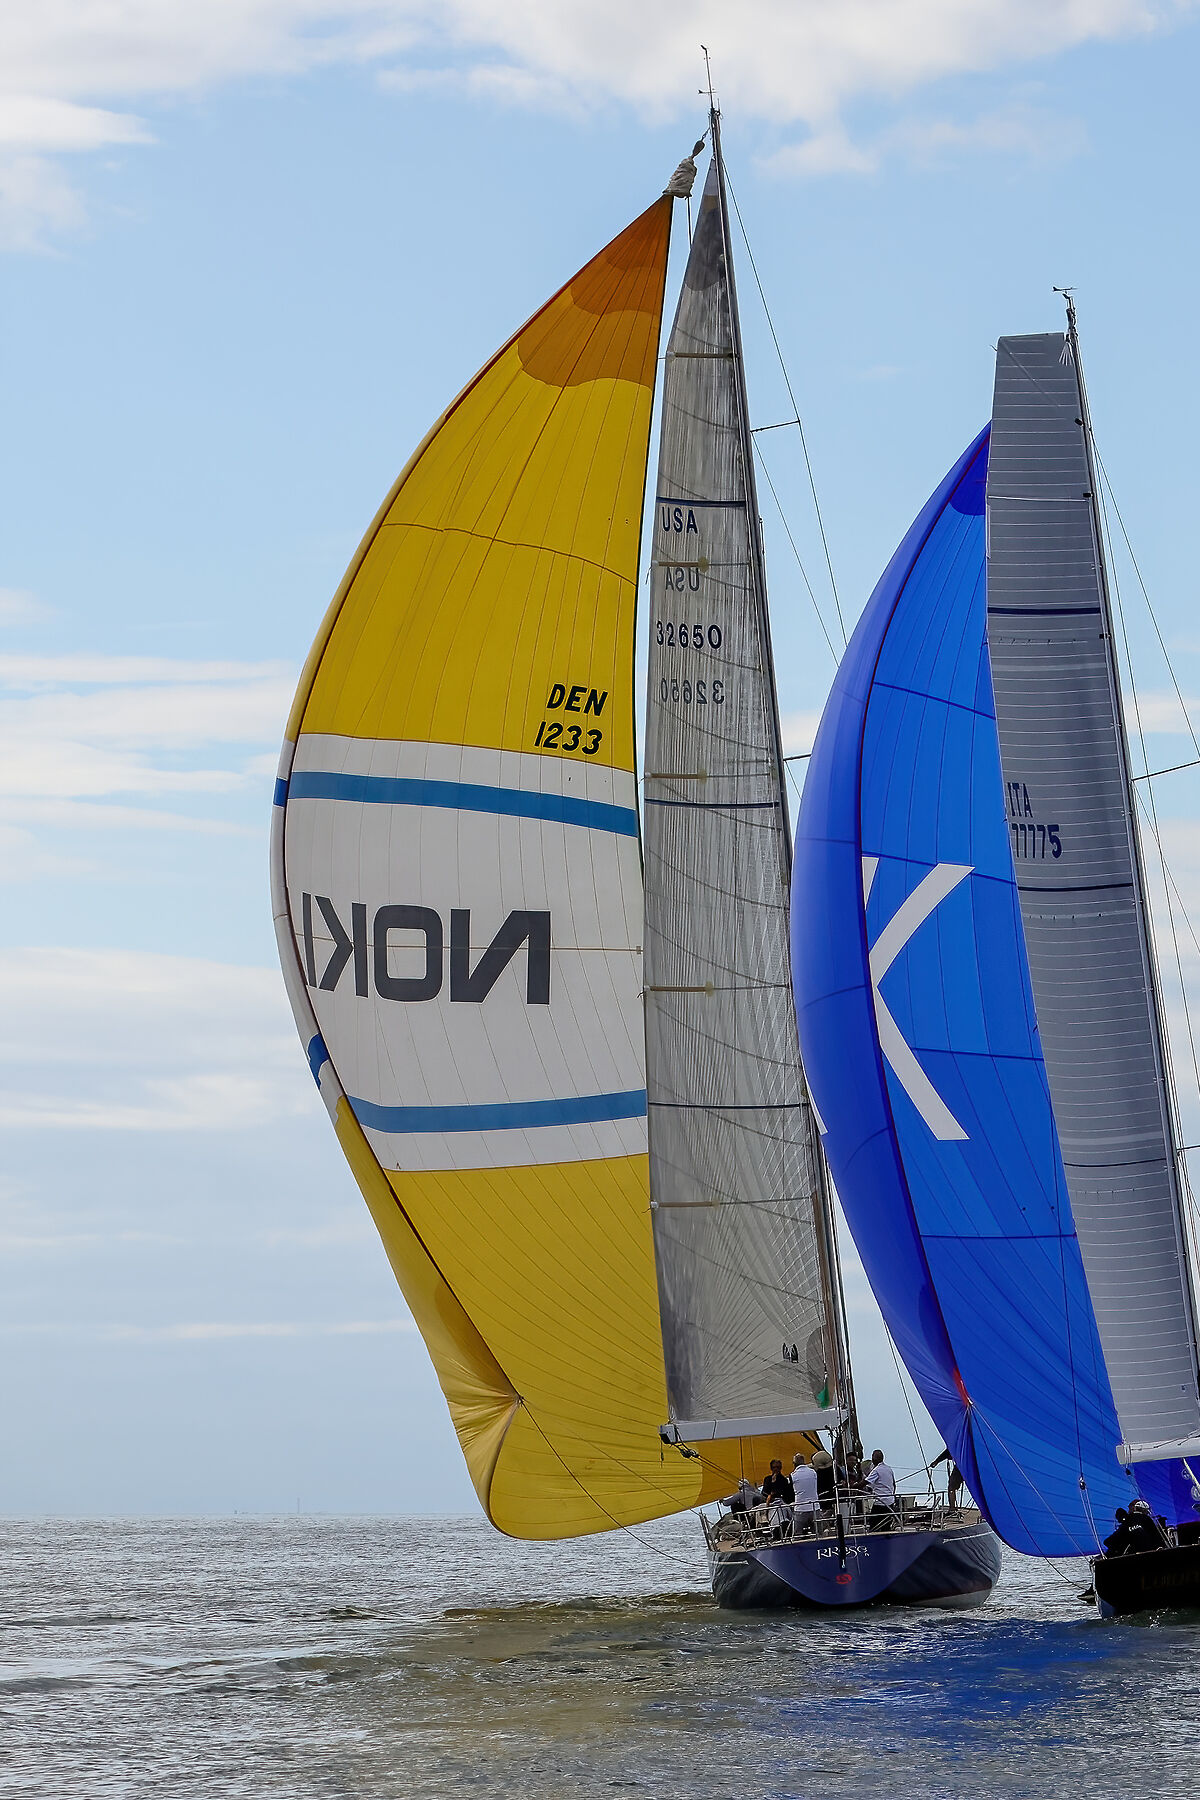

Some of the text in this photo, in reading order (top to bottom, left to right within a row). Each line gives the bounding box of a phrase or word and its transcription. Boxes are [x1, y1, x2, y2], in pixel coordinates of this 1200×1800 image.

[662, 506, 698, 534] USA
[656, 620, 722, 649] 32650
[547, 683, 608, 717] DEN
[534, 721, 603, 755] 1233
[1007, 782, 1033, 818] ITA
[1011, 823, 1062, 859] 77775
